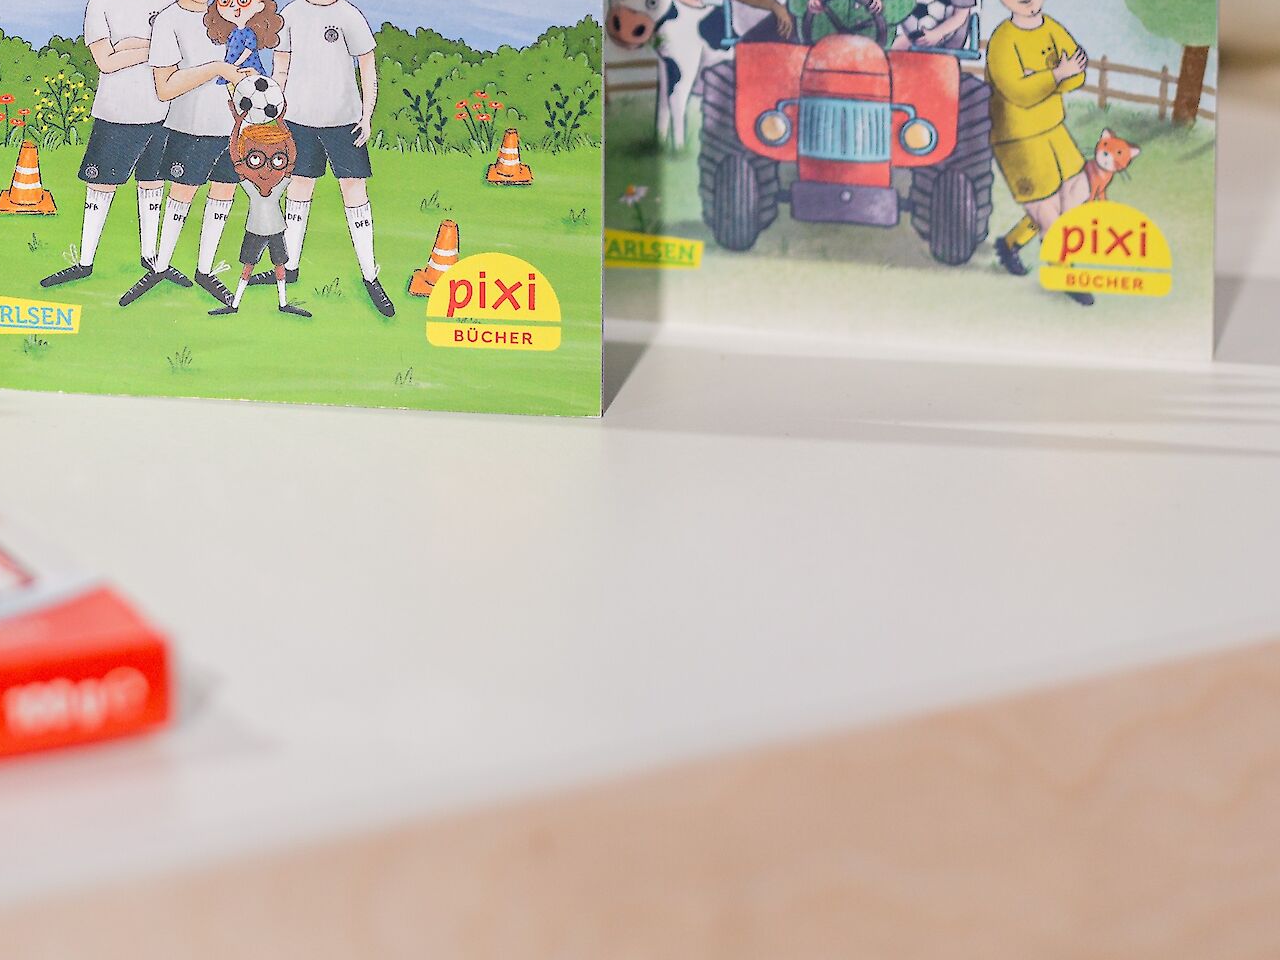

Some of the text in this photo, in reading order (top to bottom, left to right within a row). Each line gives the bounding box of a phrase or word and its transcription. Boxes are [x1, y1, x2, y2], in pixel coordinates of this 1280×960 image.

[354, 219, 371, 229] DFB
[604, 238, 696, 265] ARLSEN
[1059, 219, 1148, 263] pixi
[1065, 271, 1144, 291] BÜCHER
[445, 270, 537, 319] pixi
[453, 327, 533, 345] BÜCHER
